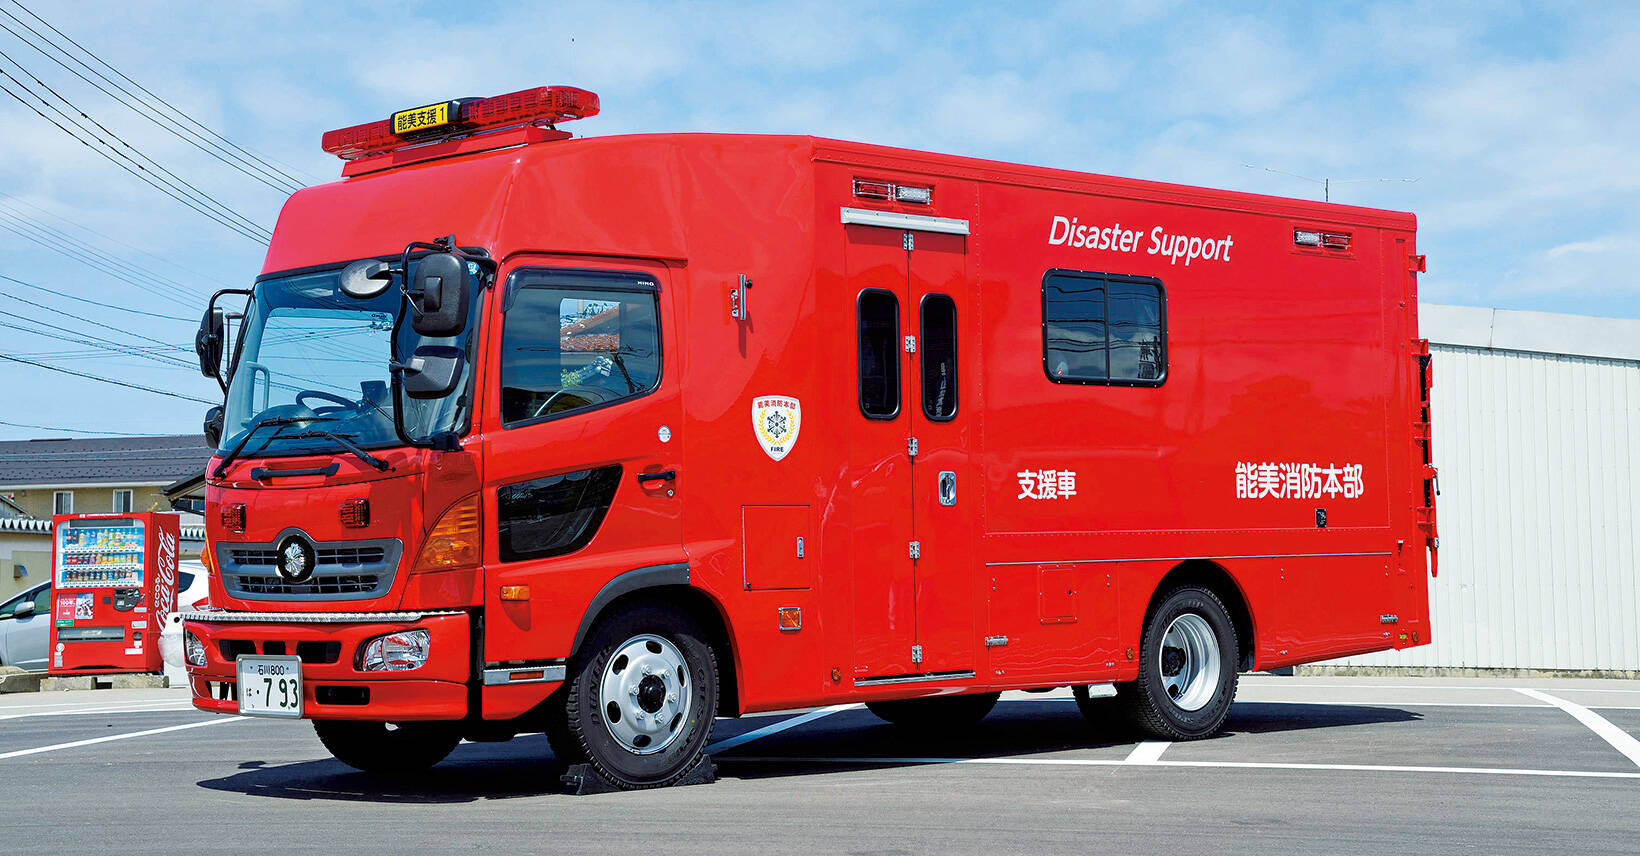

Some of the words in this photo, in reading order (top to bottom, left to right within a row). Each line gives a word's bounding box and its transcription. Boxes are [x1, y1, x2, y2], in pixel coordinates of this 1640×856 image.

[1048, 215, 1144, 253] Disaster
[1147, 226, 1234, 266] Support
[1016, 469, 1077, 500] 支援車
[1235, 461, 1364, 499] 能美消防本部
